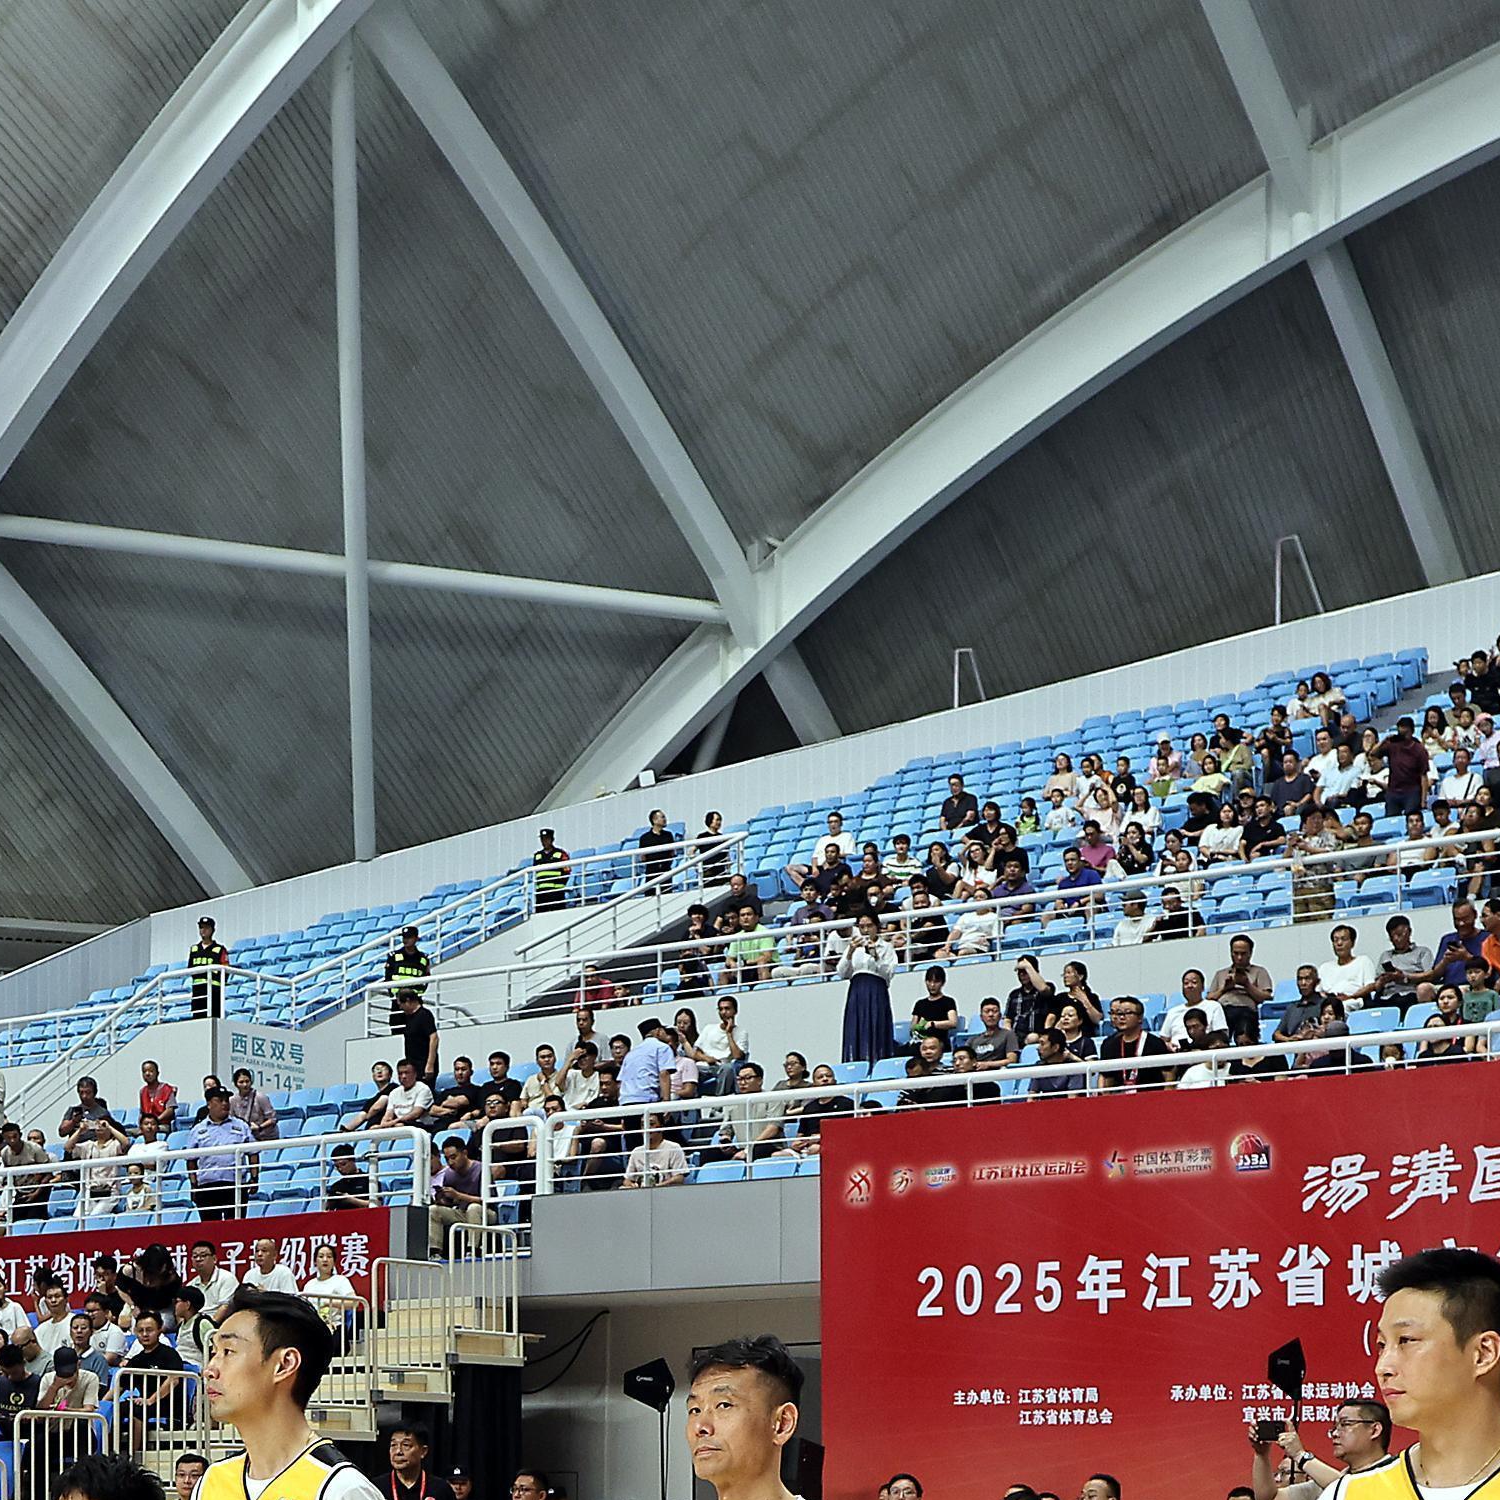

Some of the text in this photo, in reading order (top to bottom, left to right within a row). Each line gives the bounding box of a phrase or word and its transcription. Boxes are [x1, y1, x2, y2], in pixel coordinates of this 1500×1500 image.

[231, 1032, 304, 1065] 西区双号
[1133, 1147, 1213, 1166] 中国体育彩票
[1018, 1408, 1113, 1426] 江苏省体育总会
